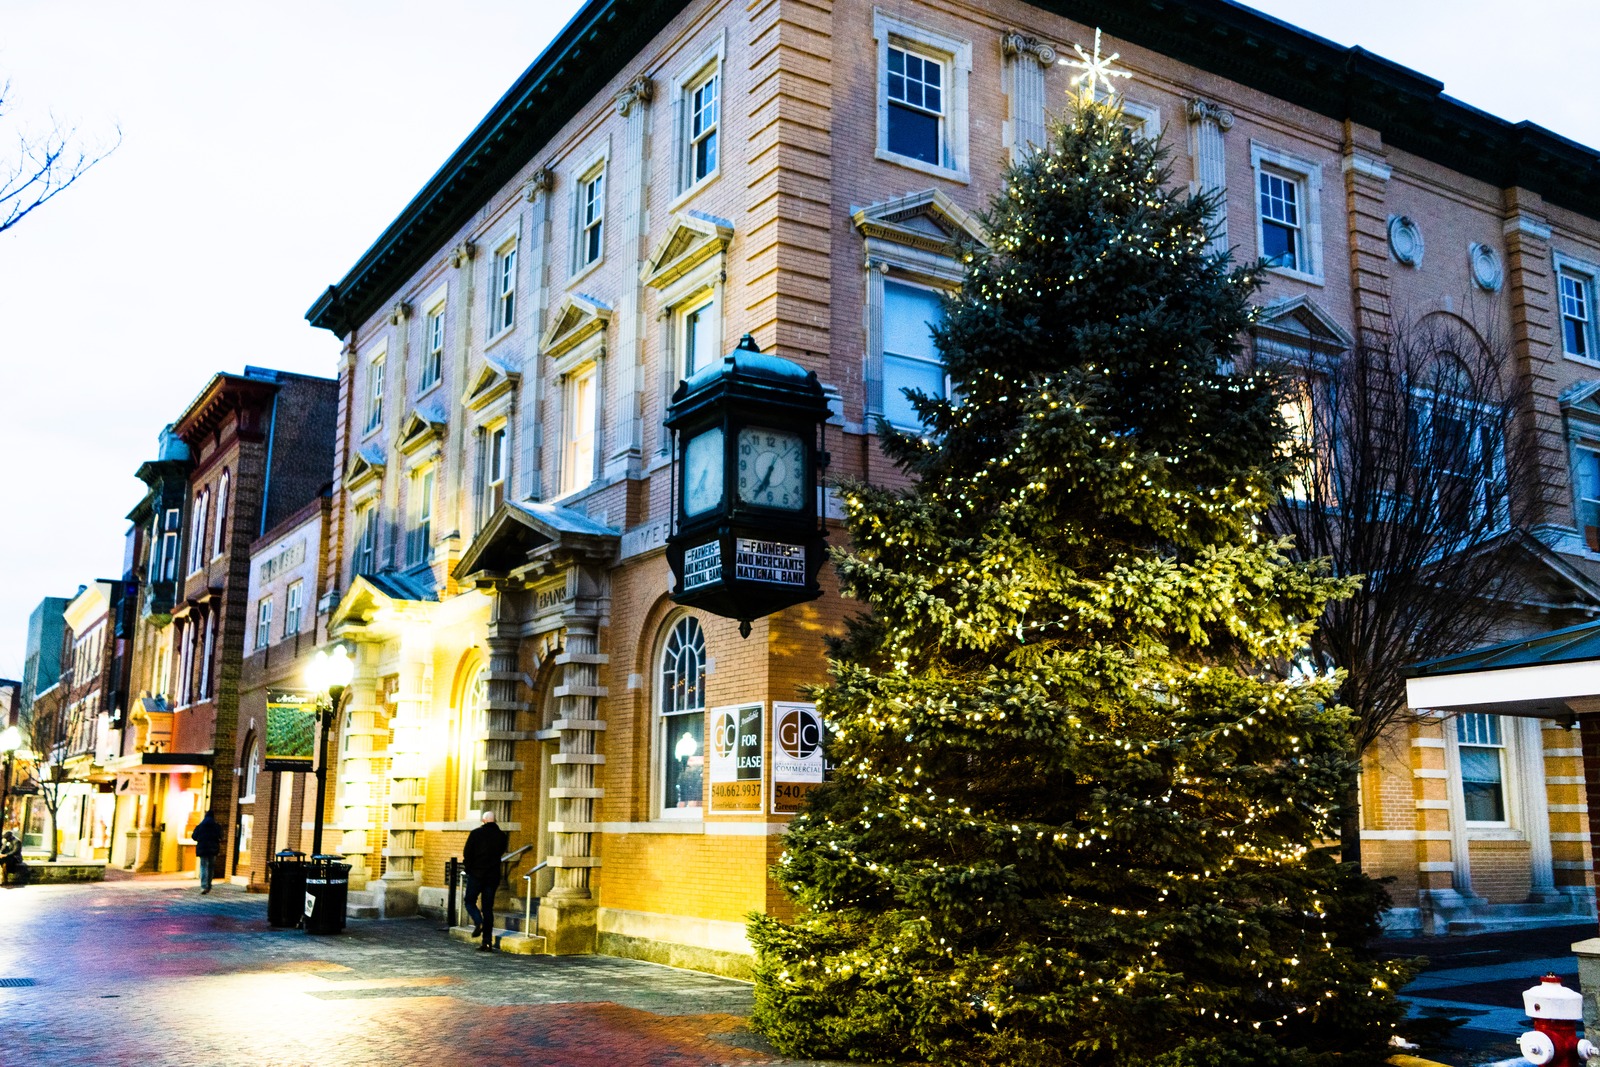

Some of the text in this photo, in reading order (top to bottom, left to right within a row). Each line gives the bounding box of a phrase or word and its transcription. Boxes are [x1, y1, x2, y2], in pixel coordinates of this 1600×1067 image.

[752, 435, 760, 446] 11
[766, 436, 776, 448] 12
[740, 444, 751, 456] 10
[794, 450, 801, 462] 2
[740, 459, 747, 471] 9
[794, 468, 801, 479] 3
[740, 477, 747, 488] 8
[766, 491, 774, 503] 6
[782, 494, 789, 505] 5
[736, 552, 804, 571] AND MERCHANTS
[737, 565, 804, 584] NATIONAL BANK
[741, 734, 758, 747] FOR
[737, 755, 762, 769] LEASE
[776, 765, 821, 774] COMMERCIAL
[711, 784, 761, 798] 540.662.9937
